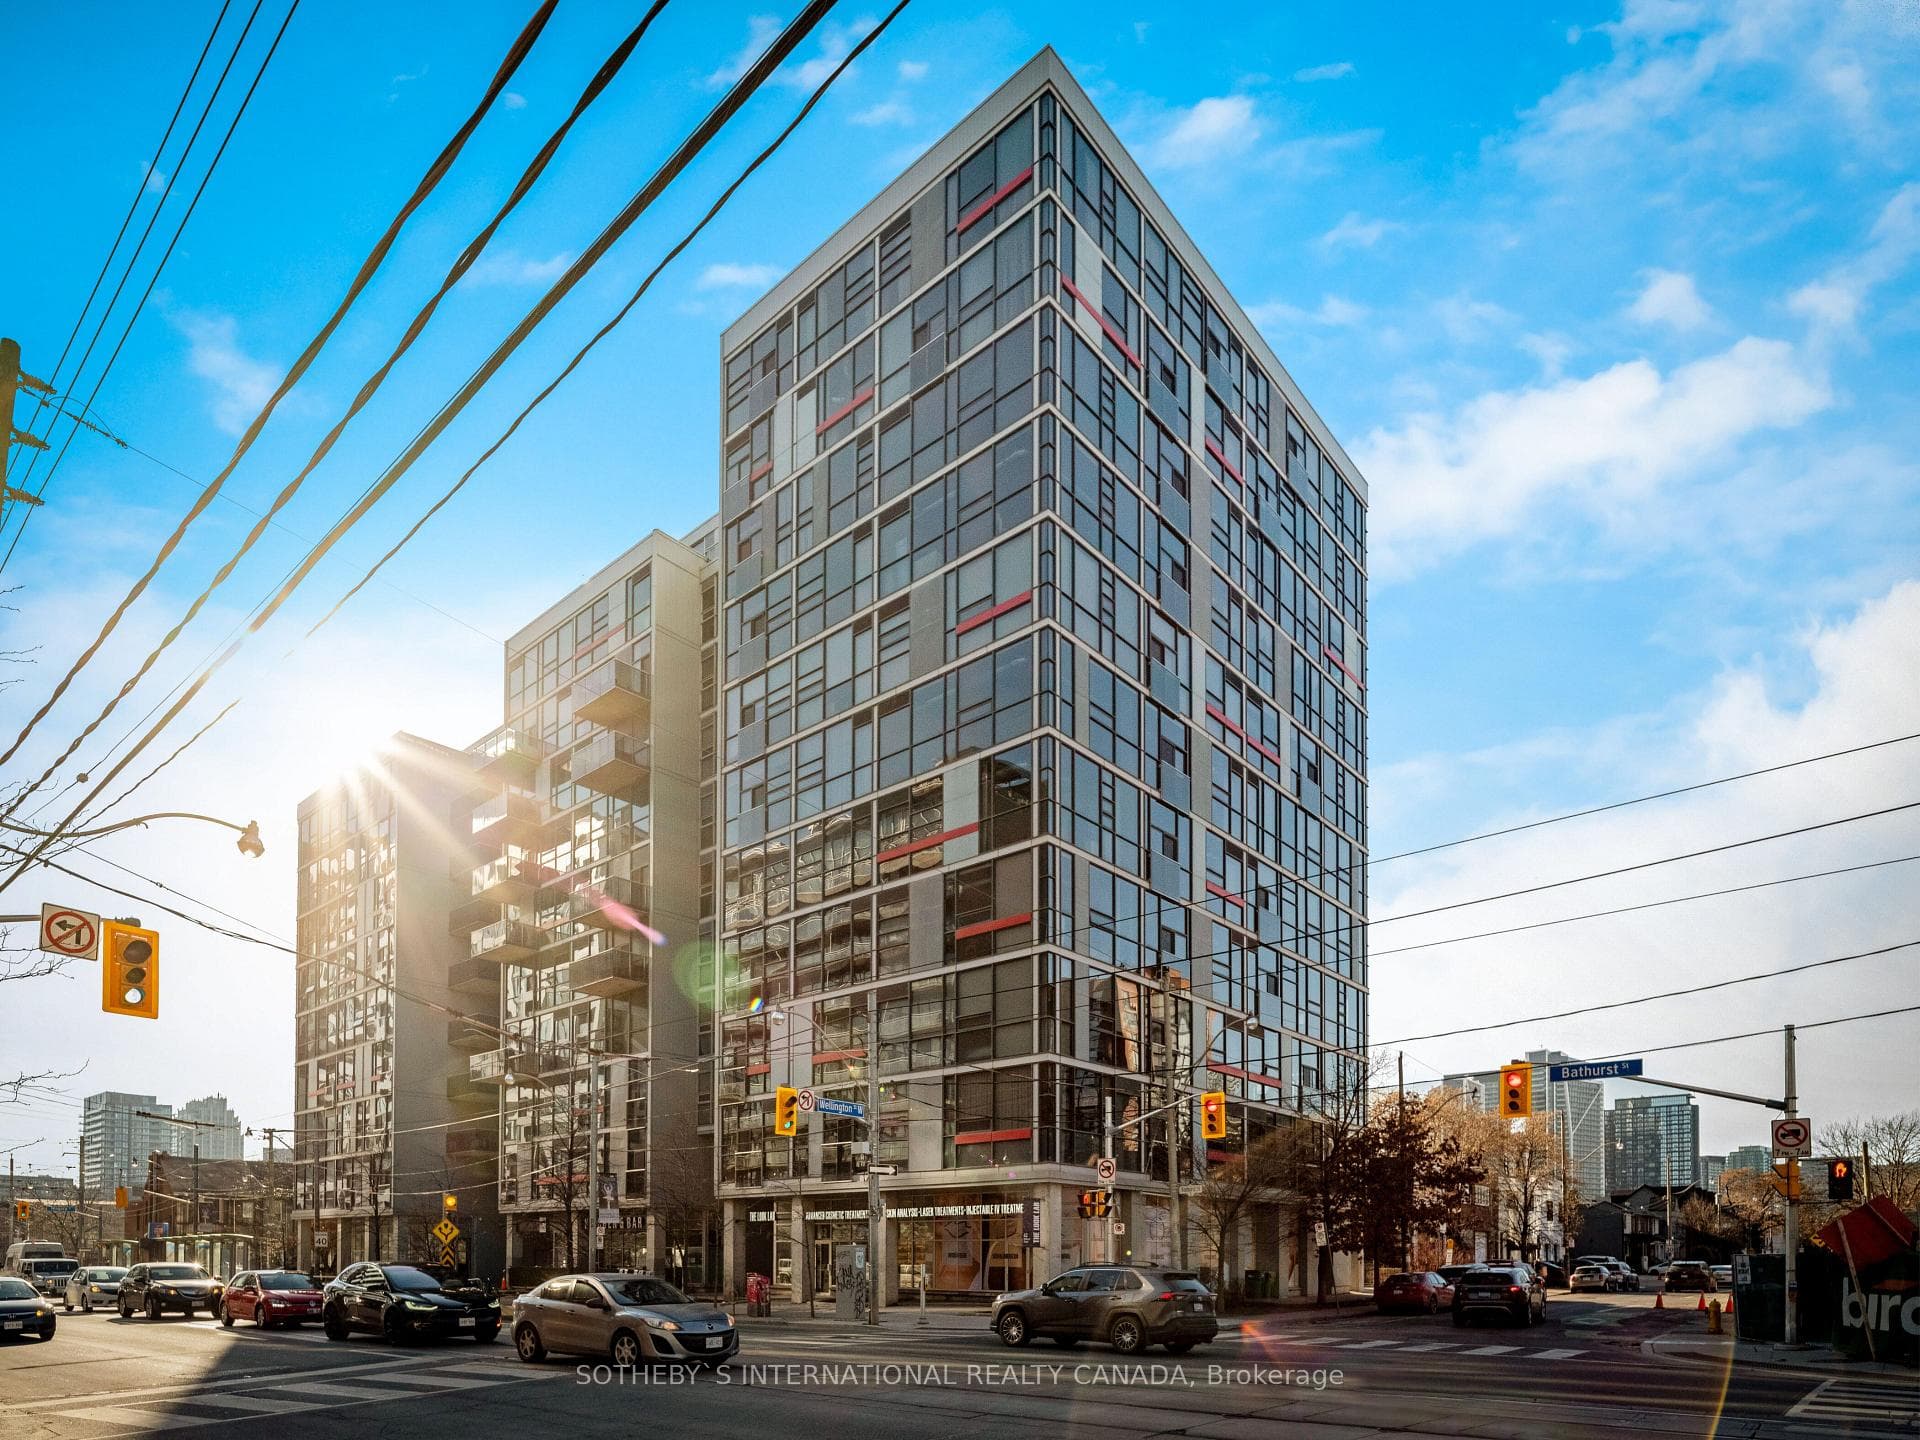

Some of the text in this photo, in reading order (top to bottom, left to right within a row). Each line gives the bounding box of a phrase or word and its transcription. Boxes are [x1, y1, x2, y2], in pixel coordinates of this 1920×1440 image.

[1561, 1063, 1619, 1078] Bathurst
[819, 1099, 853, 1113] Wellington
[857, 1105, 863, 1115] W
[626, 1216, 643, 1229] BAR
